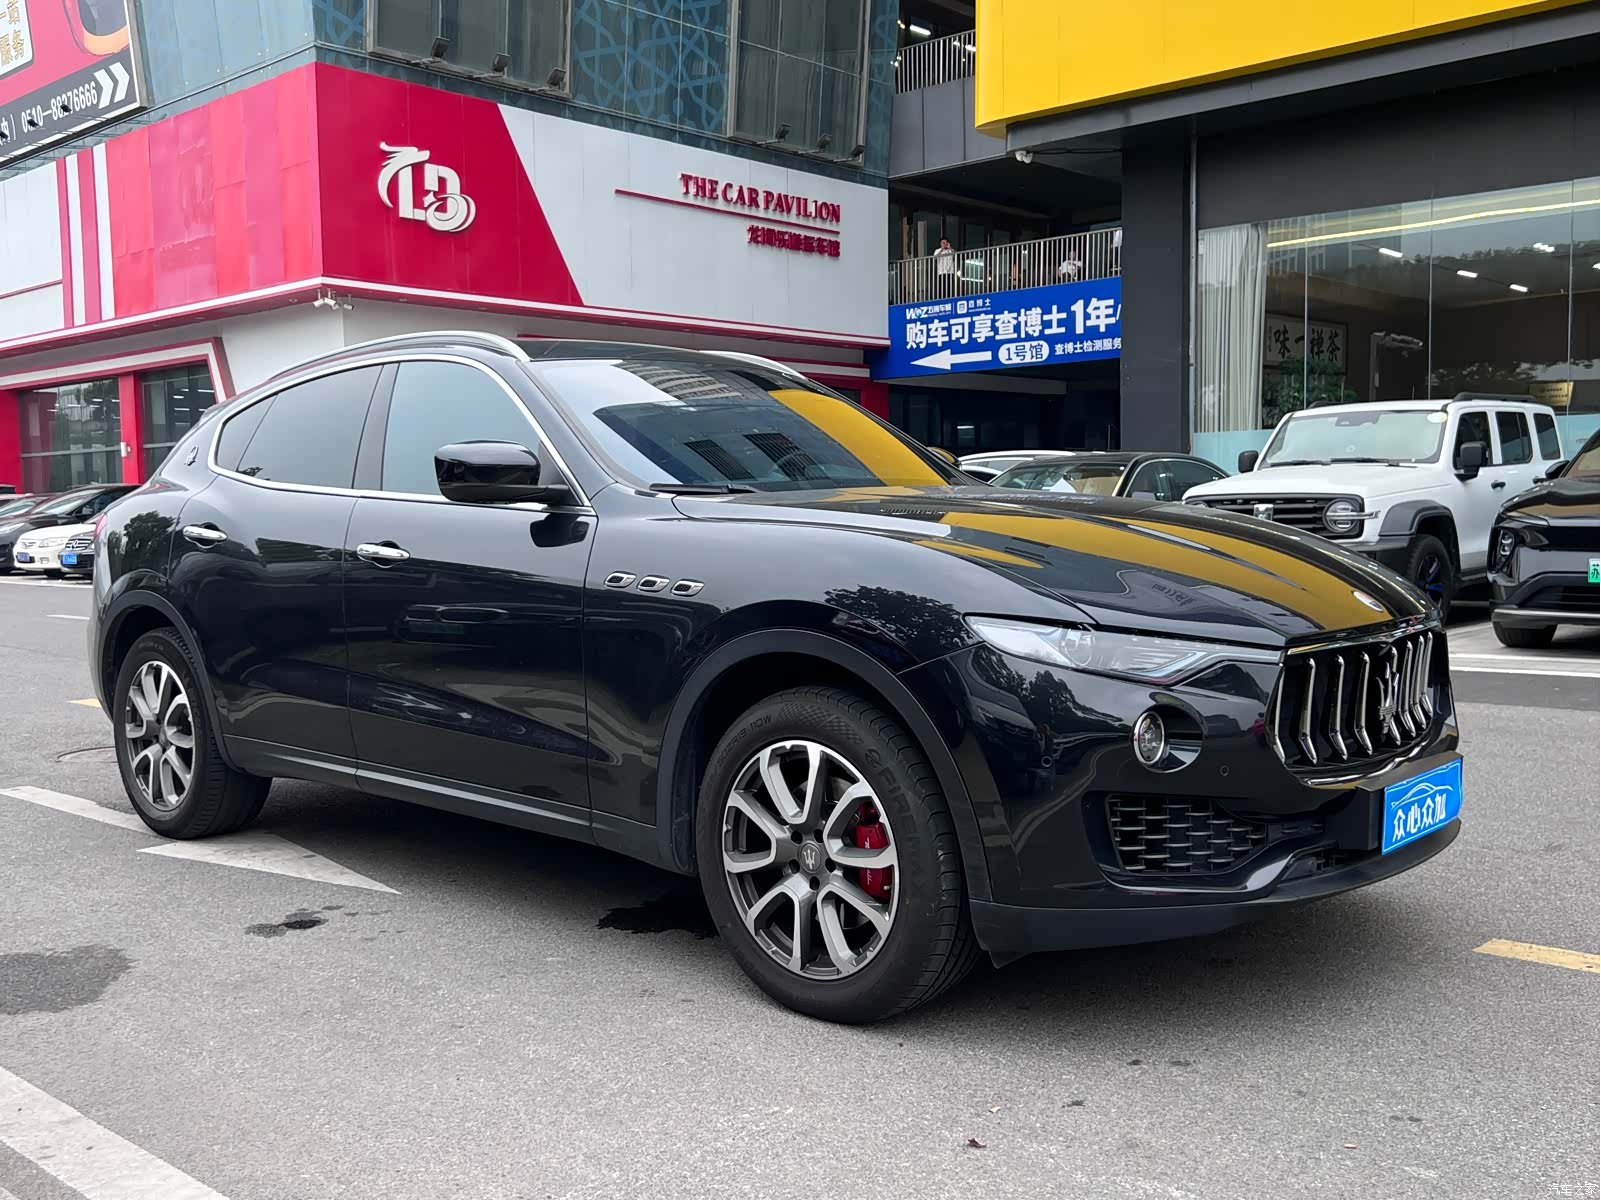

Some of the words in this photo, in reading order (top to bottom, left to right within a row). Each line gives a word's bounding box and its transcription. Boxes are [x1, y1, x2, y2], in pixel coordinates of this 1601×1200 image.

[680, 173, 719, 200] THE
[721, 182, 760, 209] CAR
[763, 190, 841, 223] PAVILION
[1005, 342, 1044, 362] 1号馆
[1054, 337, 1122, 356] 查博士检测服务
